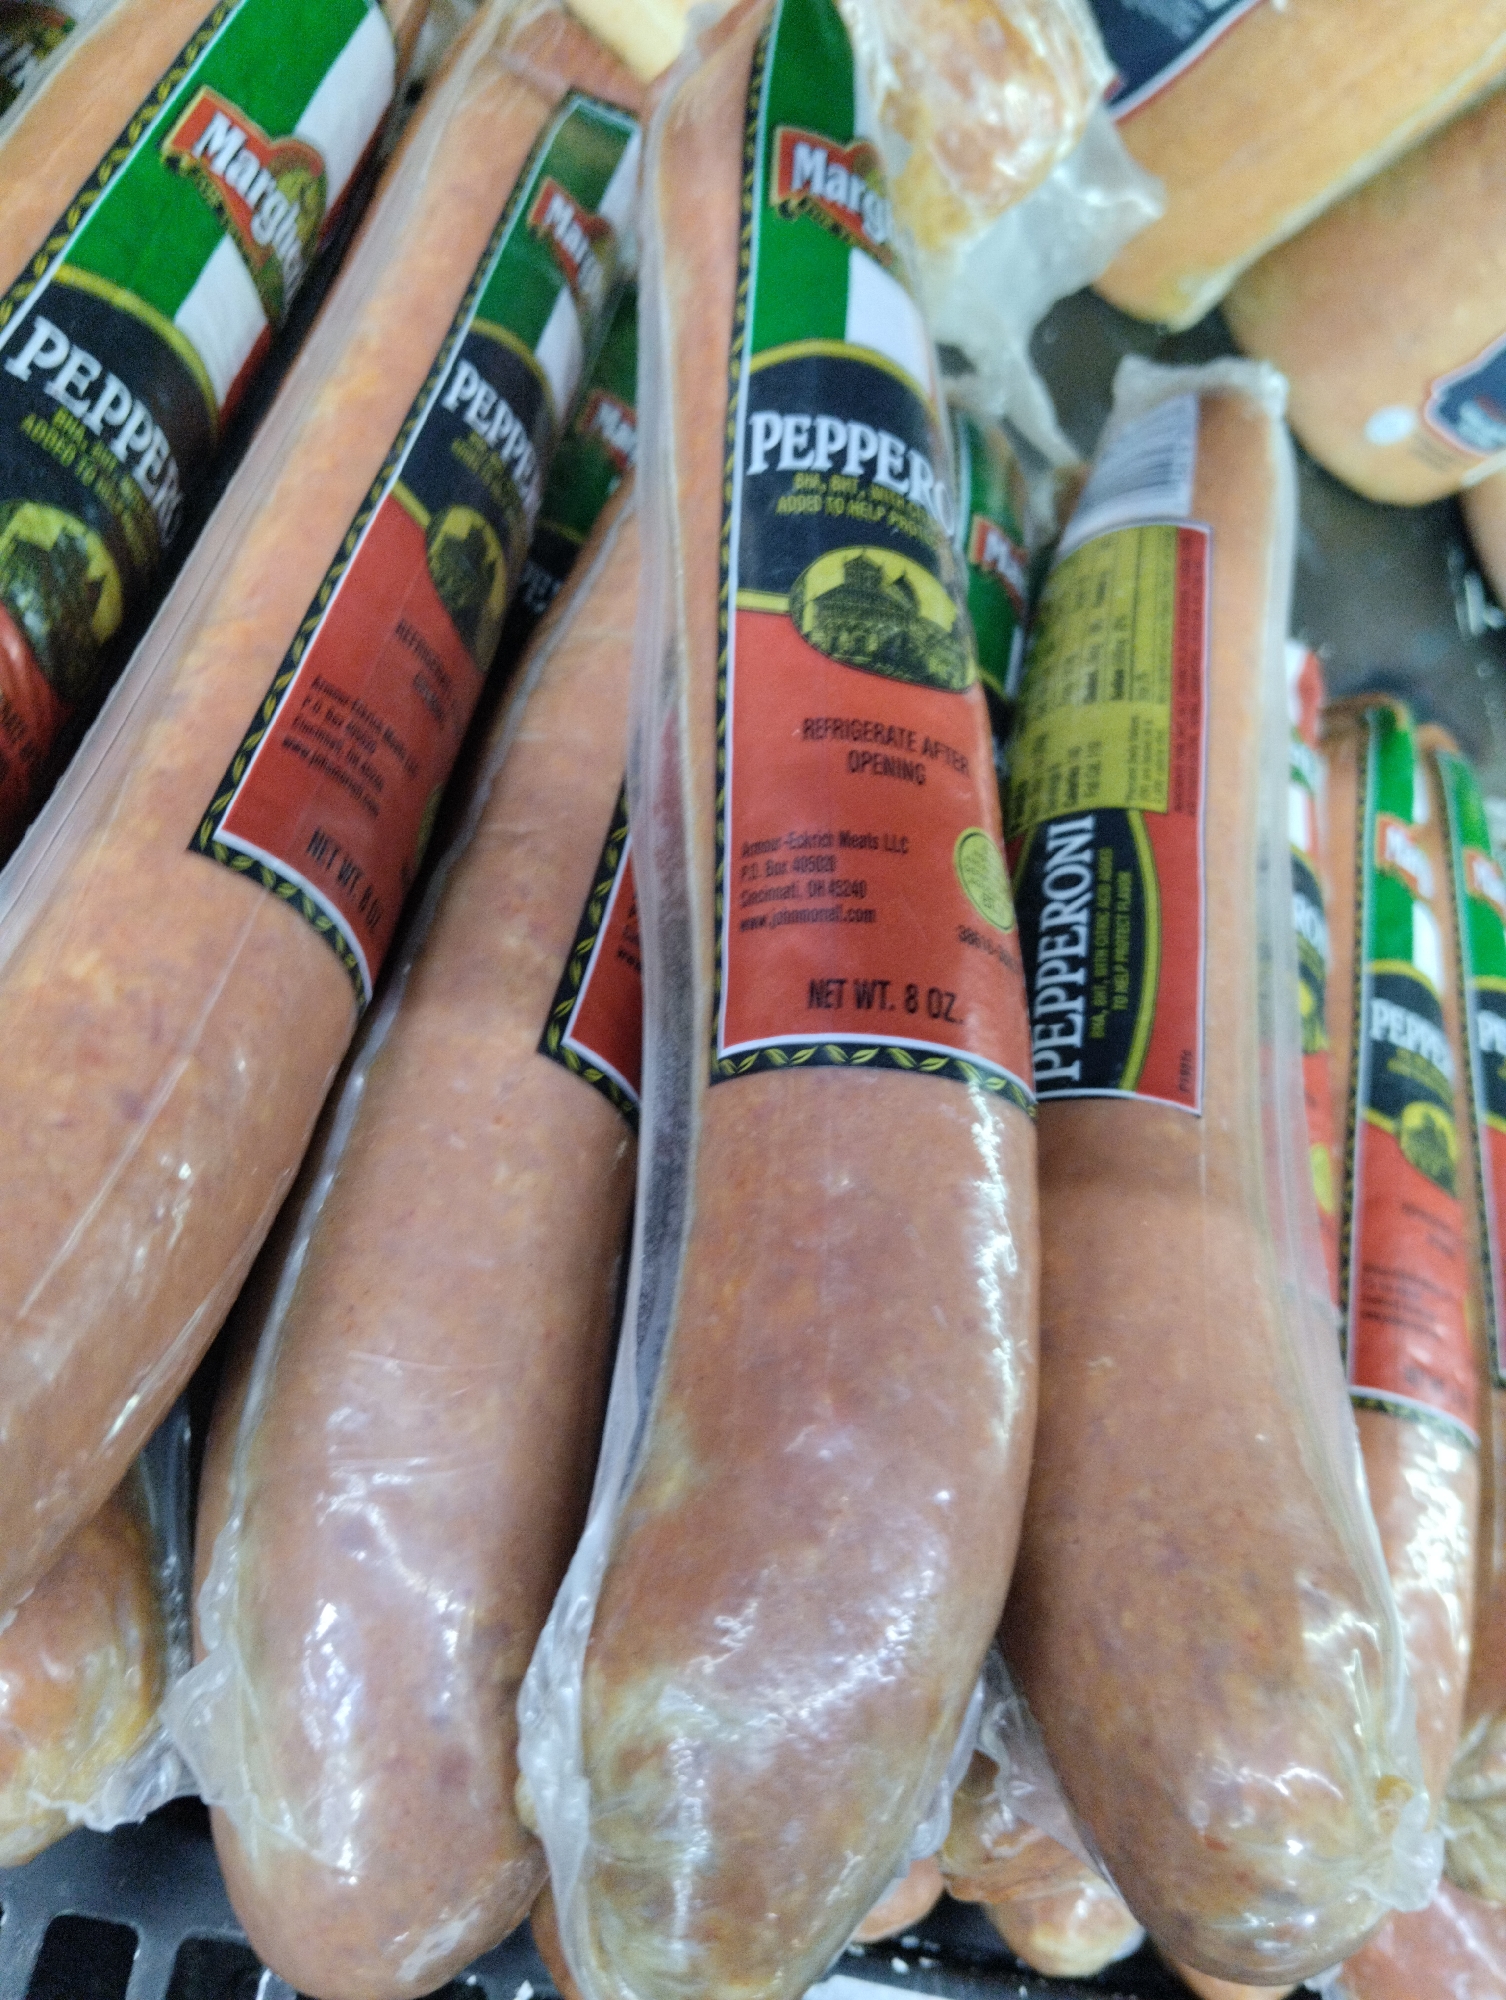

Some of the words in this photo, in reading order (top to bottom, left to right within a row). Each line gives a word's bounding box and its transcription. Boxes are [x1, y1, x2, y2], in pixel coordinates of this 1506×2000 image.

[802, 717, 917, 752] REFRIGERATE
[922, 736, 970, 776] AFTER
[847, 750, 926, 785] OPENING
[1034, 814, 1096, 1082] PEPPERONI
[808, 978, 847, 1010] NET
[853, 979, 895, 1012] WT.
[905, 983, 919, 1014] 8
[927, 987, 964, 1025] OZ.
